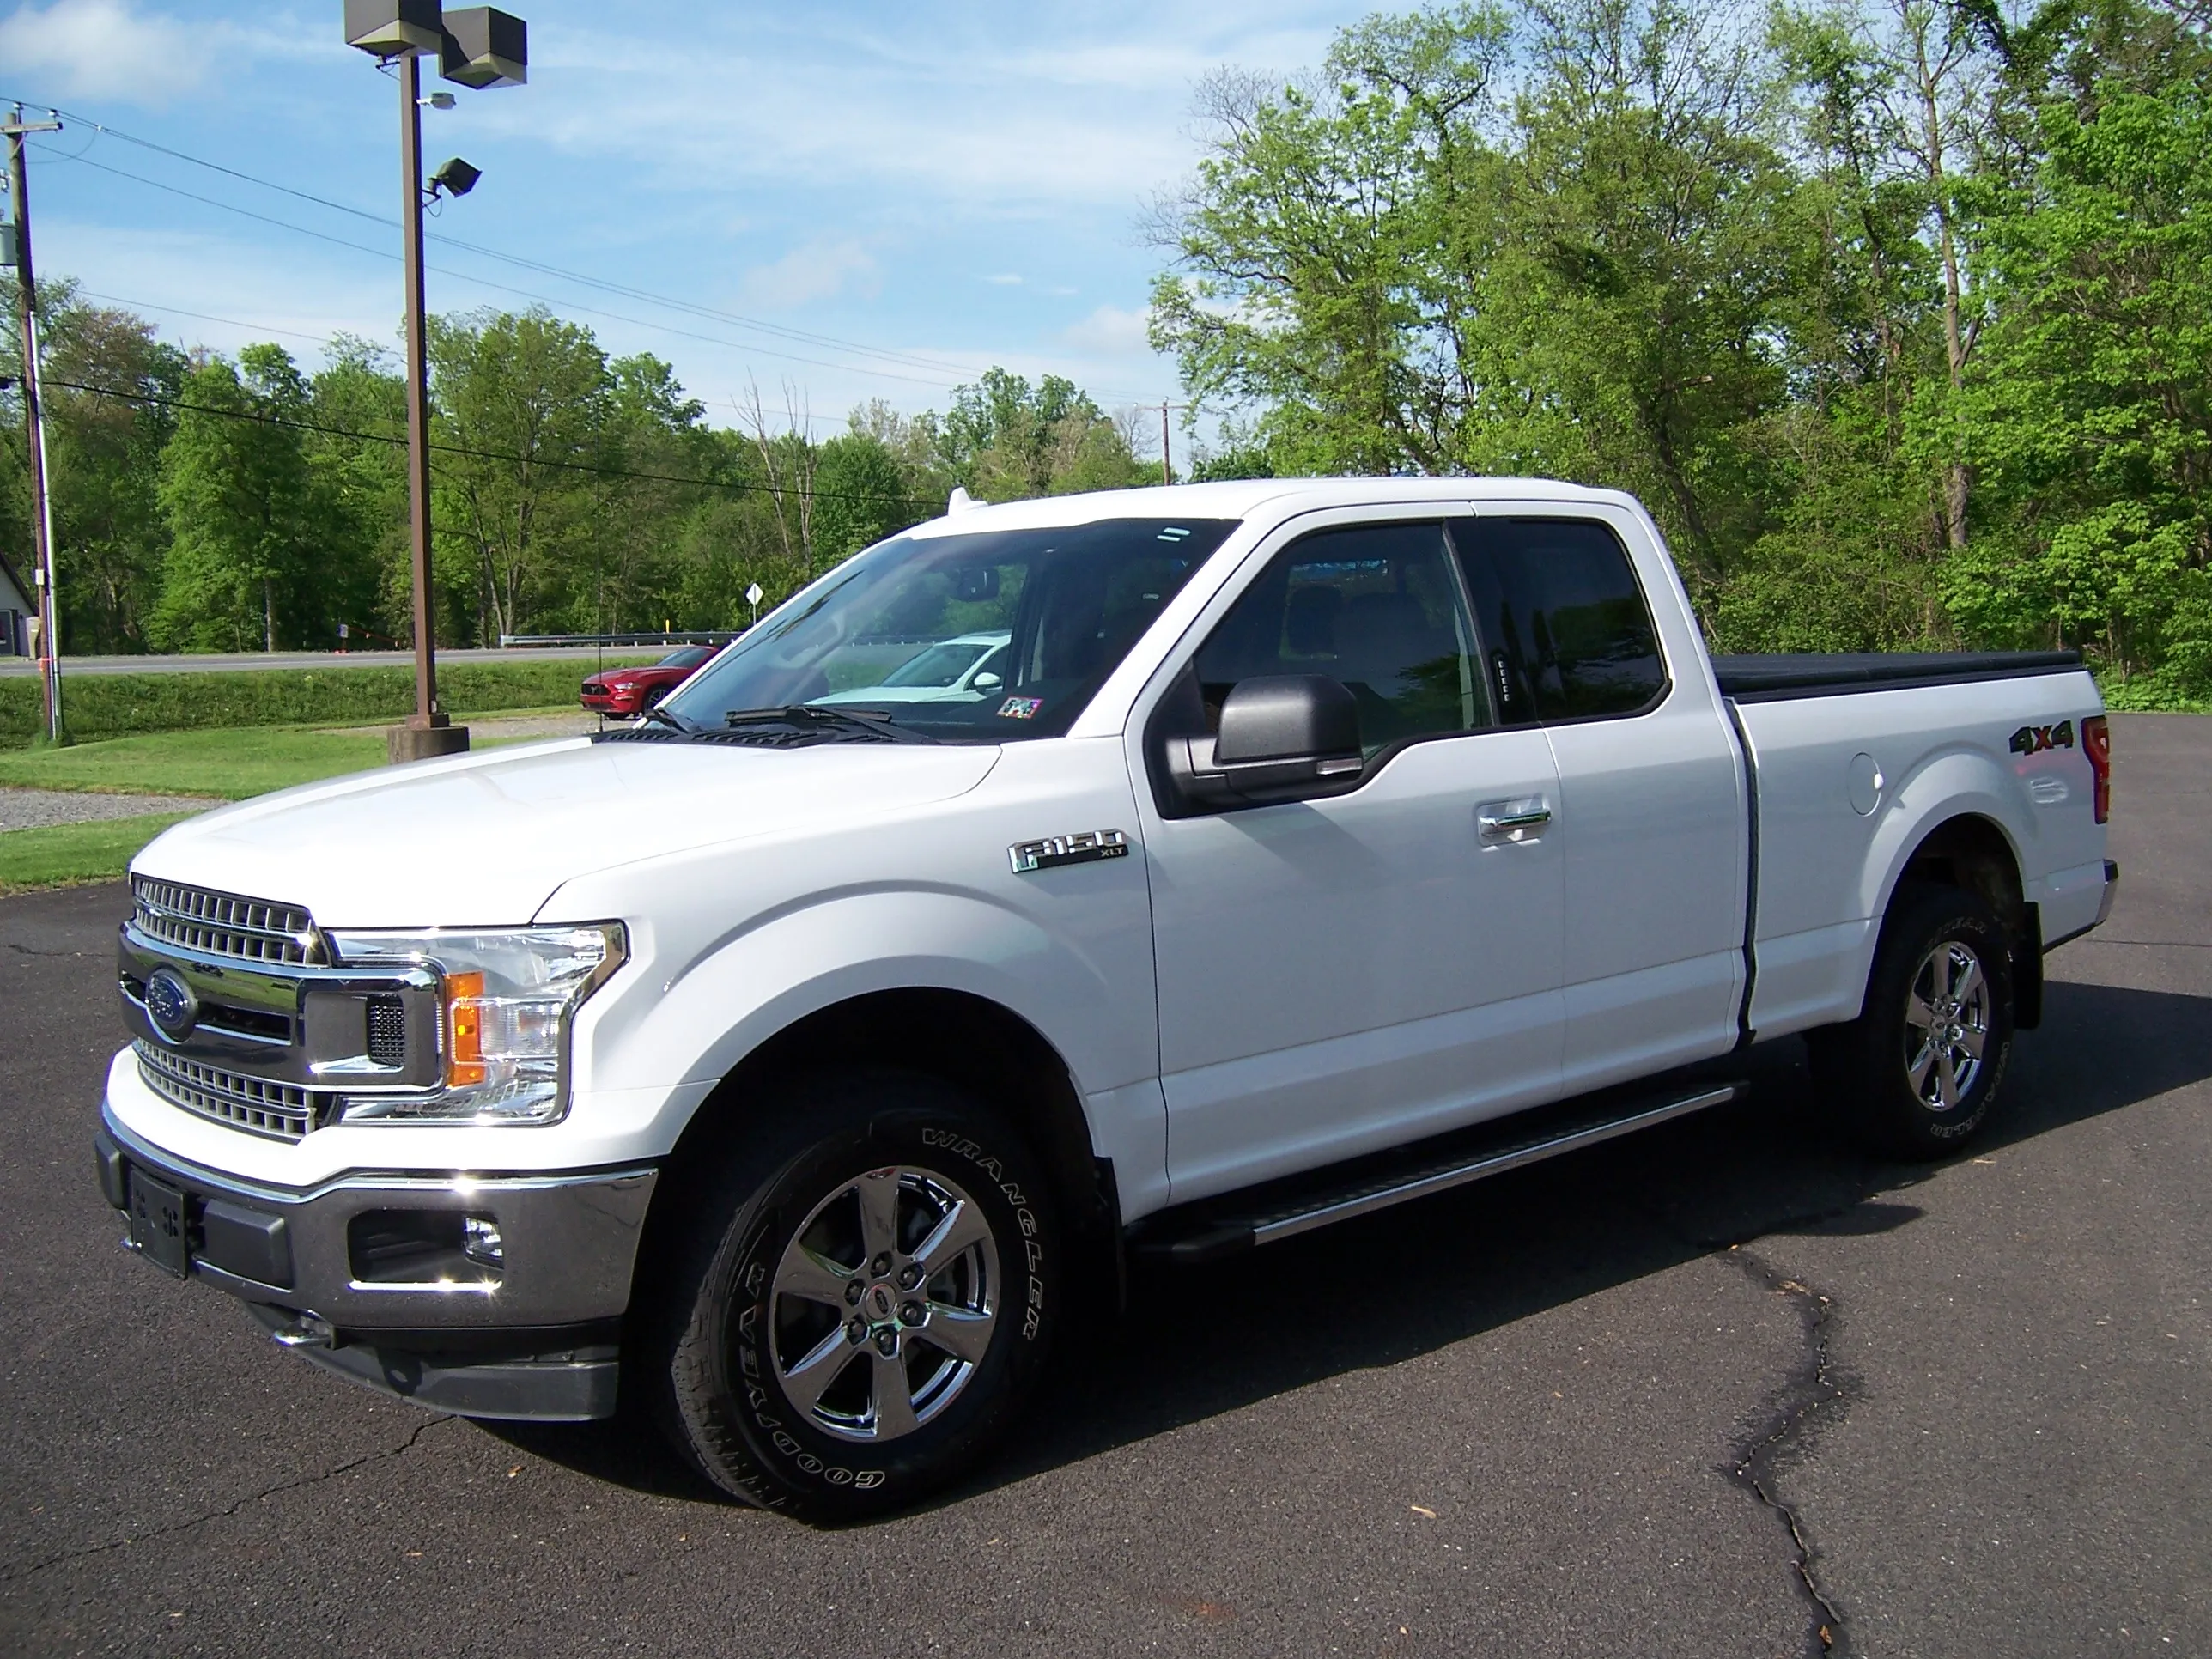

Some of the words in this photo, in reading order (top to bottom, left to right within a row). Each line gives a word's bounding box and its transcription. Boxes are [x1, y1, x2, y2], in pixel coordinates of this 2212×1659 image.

[1101, 847, 1125, 858] XLT
[921, 1127, 1043, 1340] WRANGLER
[739, 1262, 885, 1488] GOODYEAR
